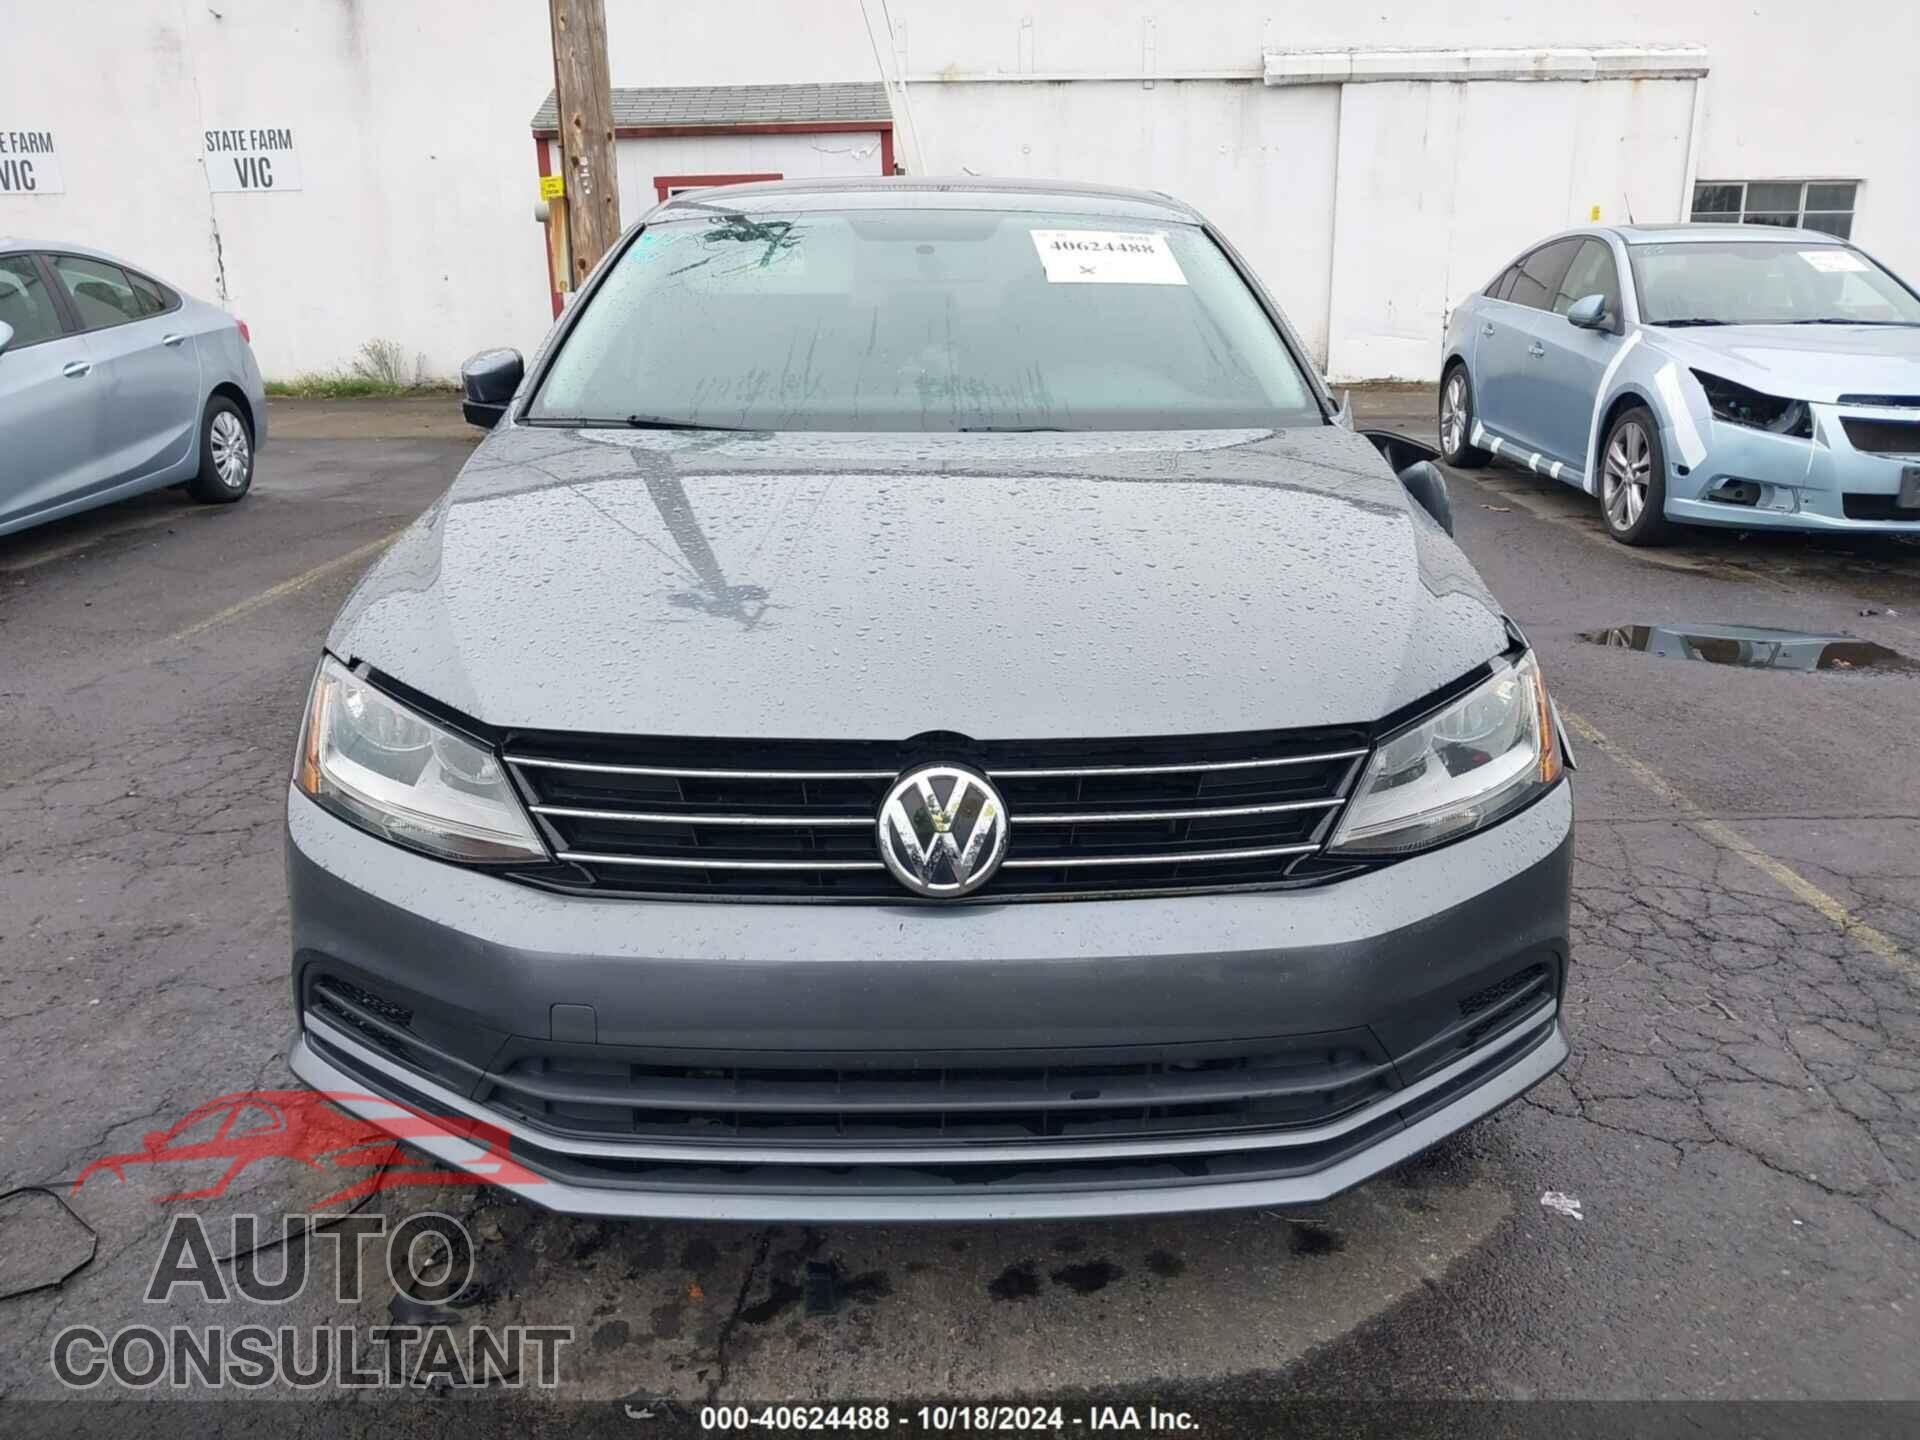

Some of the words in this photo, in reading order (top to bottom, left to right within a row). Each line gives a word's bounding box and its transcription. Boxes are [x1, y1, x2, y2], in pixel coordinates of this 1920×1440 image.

[9, 132, 54, 153] FARM
[205, 130, 247, 152] STATE
[250, 129, 293, 151] FARM
[233, 156, 273, 188] VIC
[1050, 239, 1155, 254] 40624488
